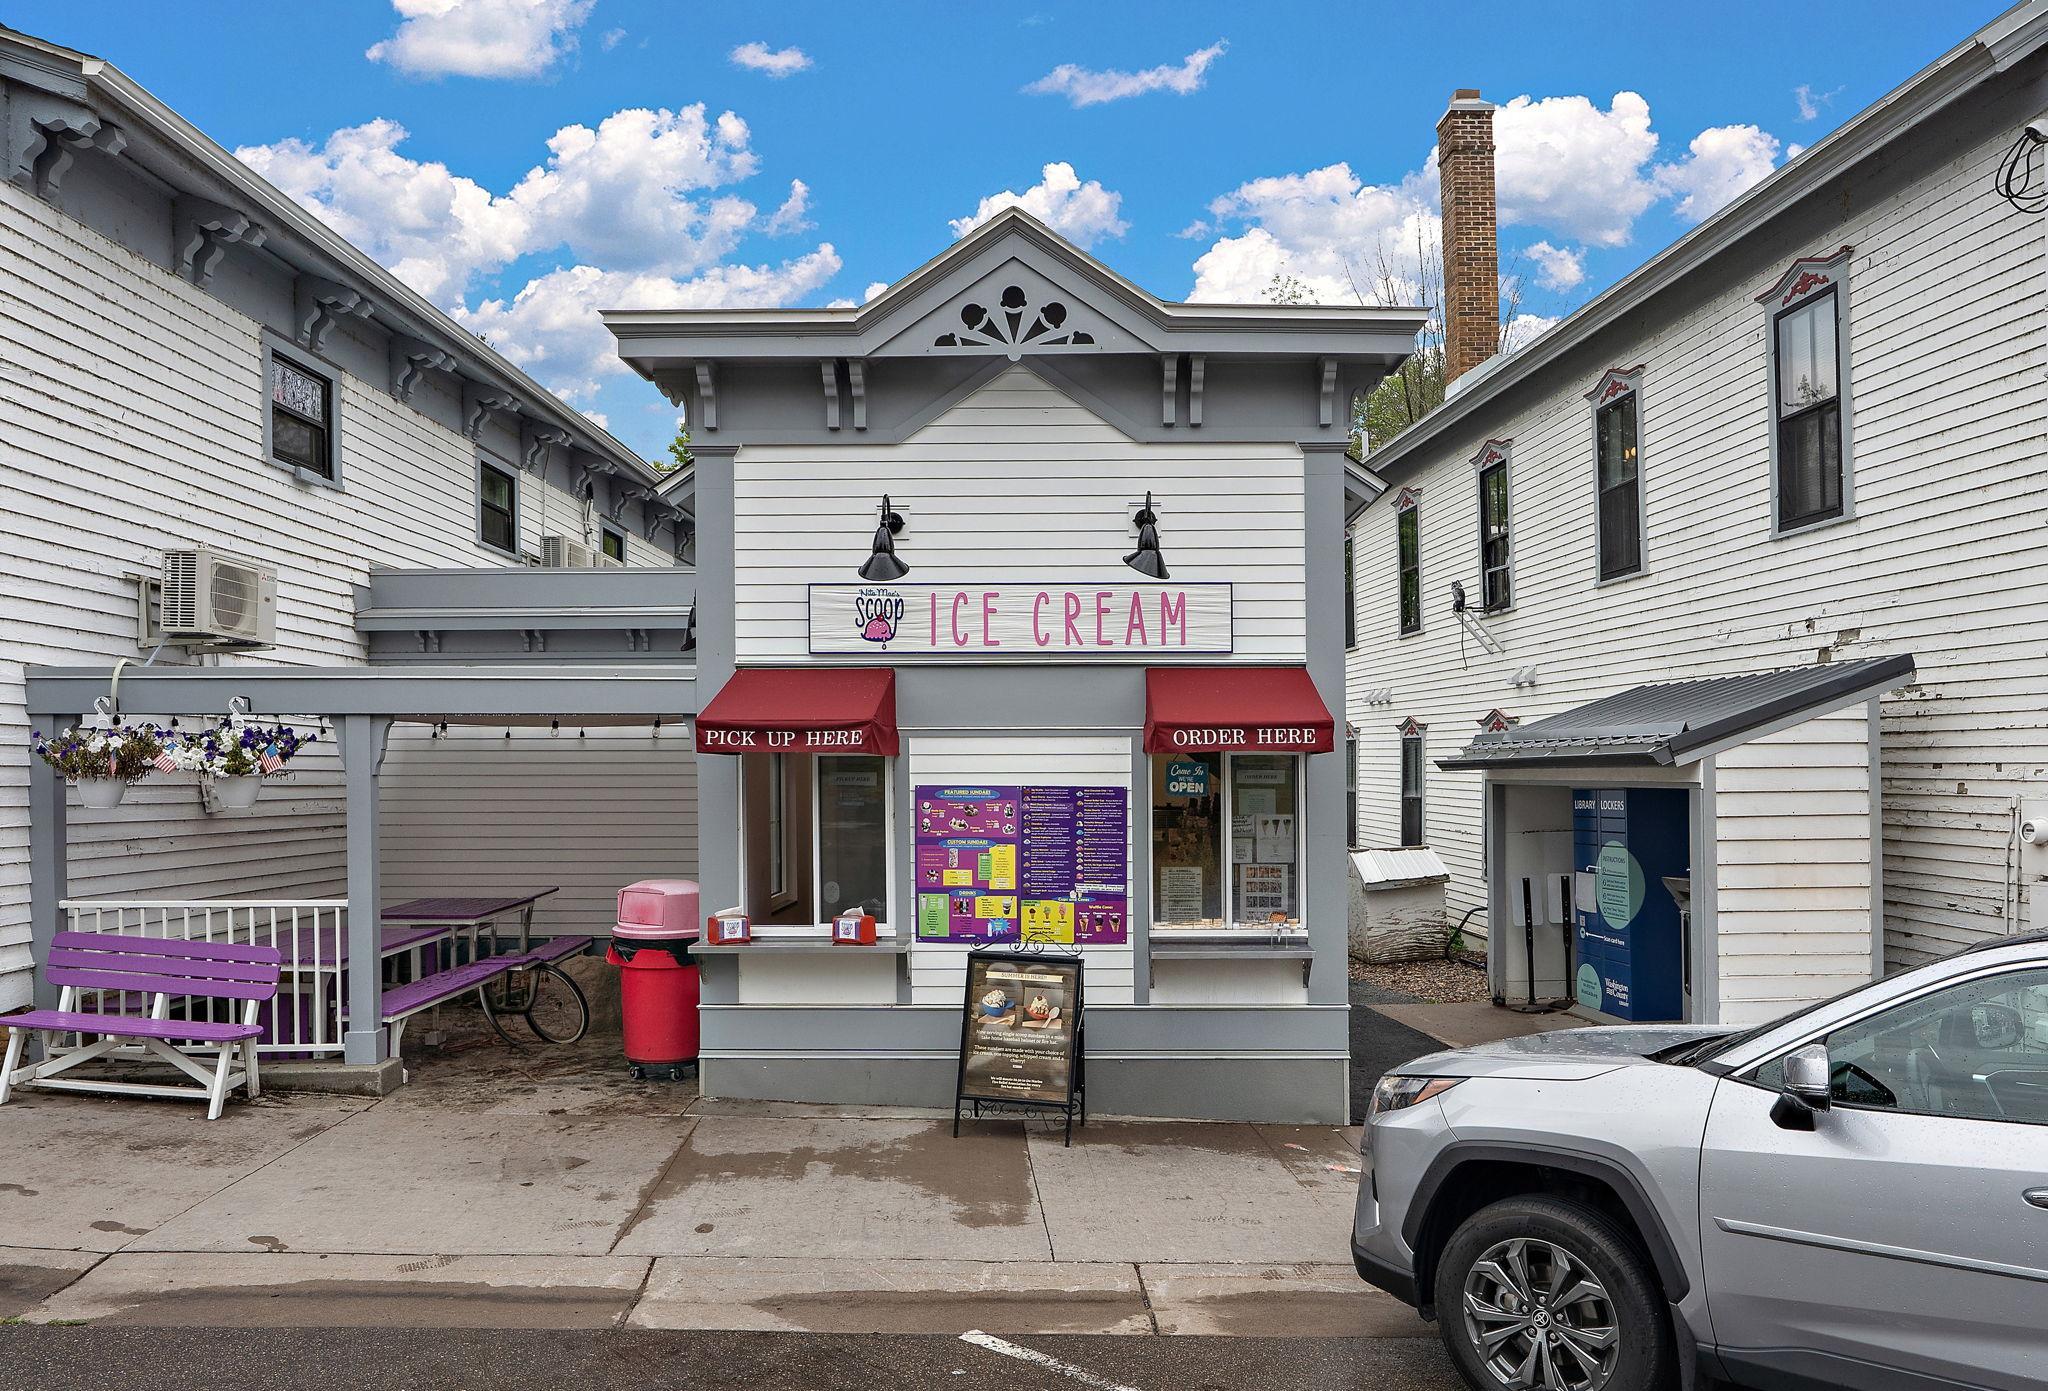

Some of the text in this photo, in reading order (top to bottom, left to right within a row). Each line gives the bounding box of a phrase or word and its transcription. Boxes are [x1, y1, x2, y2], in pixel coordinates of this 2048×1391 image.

[930, 591, 1187, 646] ICE CREAM
[705, 730, 863, 746] PICK UP HERE
[1173, 728, 1316, 746] ORDER HERE
[1170, 764, 1204, 776] Come In
[1170, 782, 1204, 793] OPEN
[1574, 800, 1624, 810] LIBRARY LOCKERS
[1605, 978, 1628, 992] Washington
[1613, 988, 1628, 1002] County
